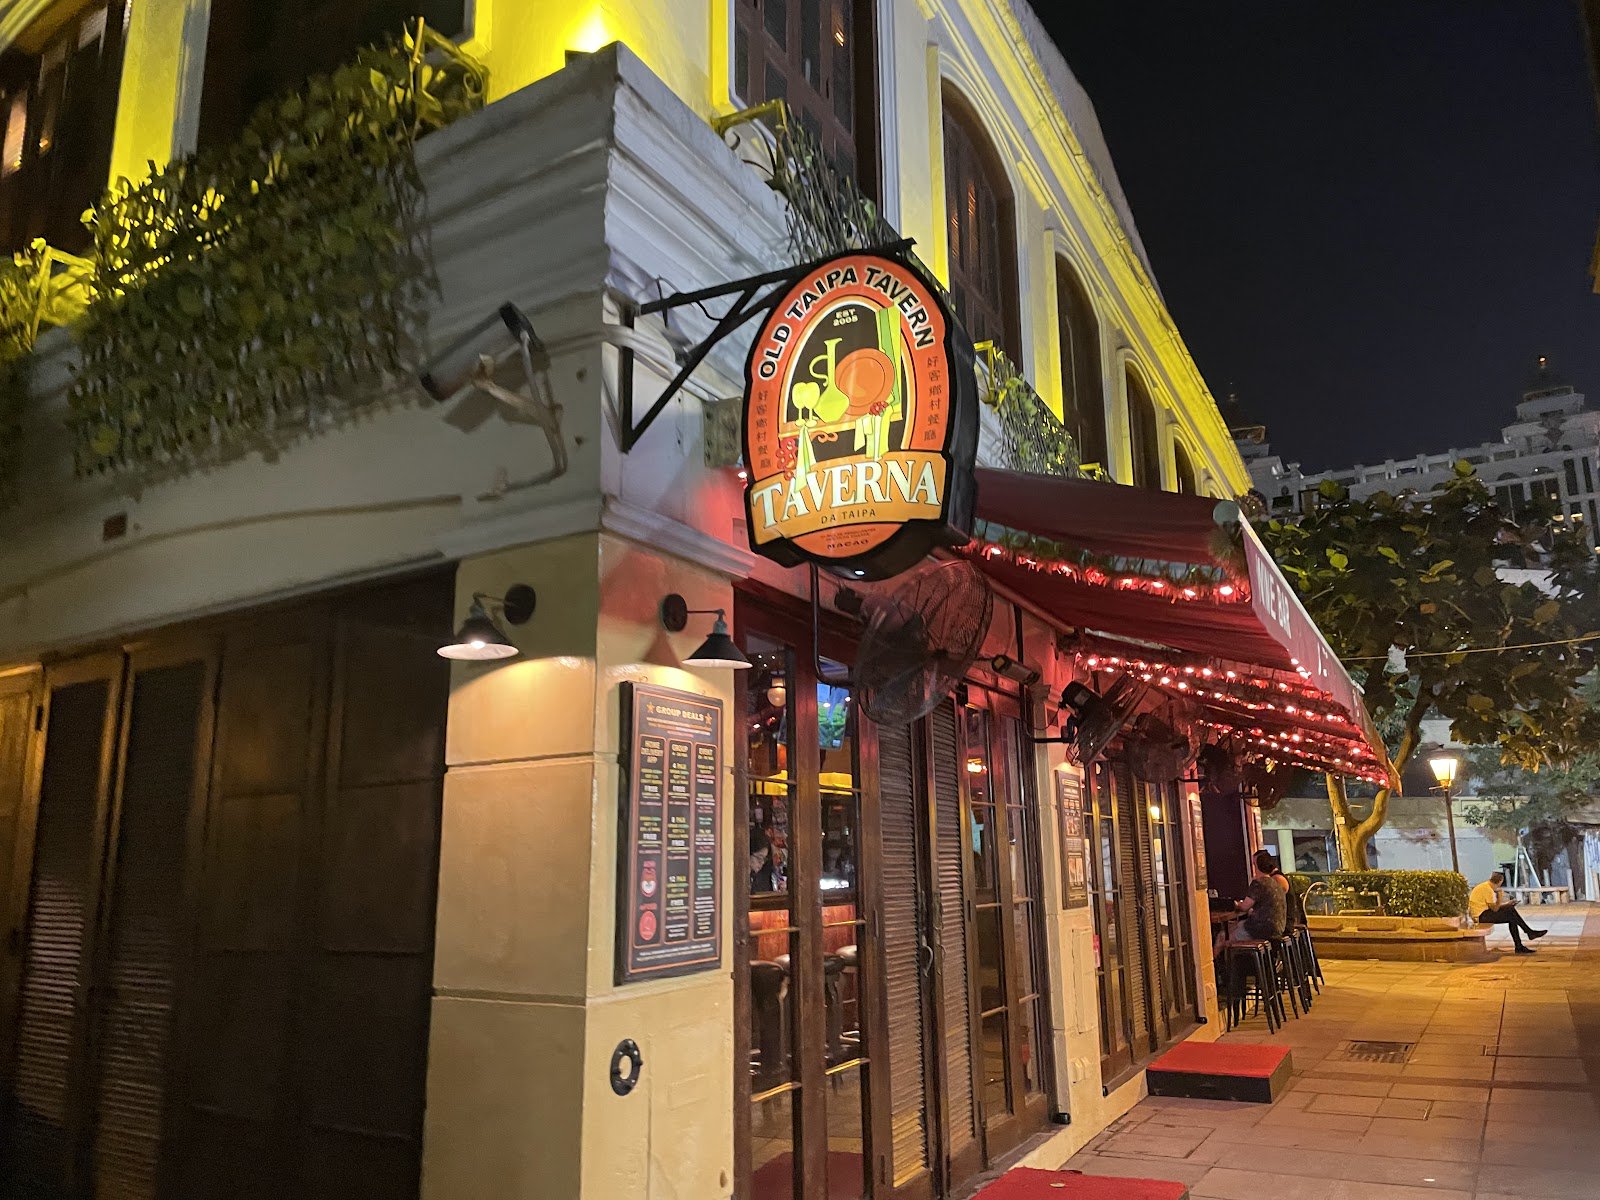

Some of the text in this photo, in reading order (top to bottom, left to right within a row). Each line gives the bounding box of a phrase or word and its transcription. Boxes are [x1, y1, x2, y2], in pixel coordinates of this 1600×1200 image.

[835, 308, 856, 319] EST
[758, 266, 935, 379] OLD TAIPA TAVERN
[752, 459, 942, 530] TAVERNA
[820, 508, 877, 525] DA TAIPA
[826, 539, 869, 550] MACAO
[655, 705, 705, 722] GROUP DEALS
